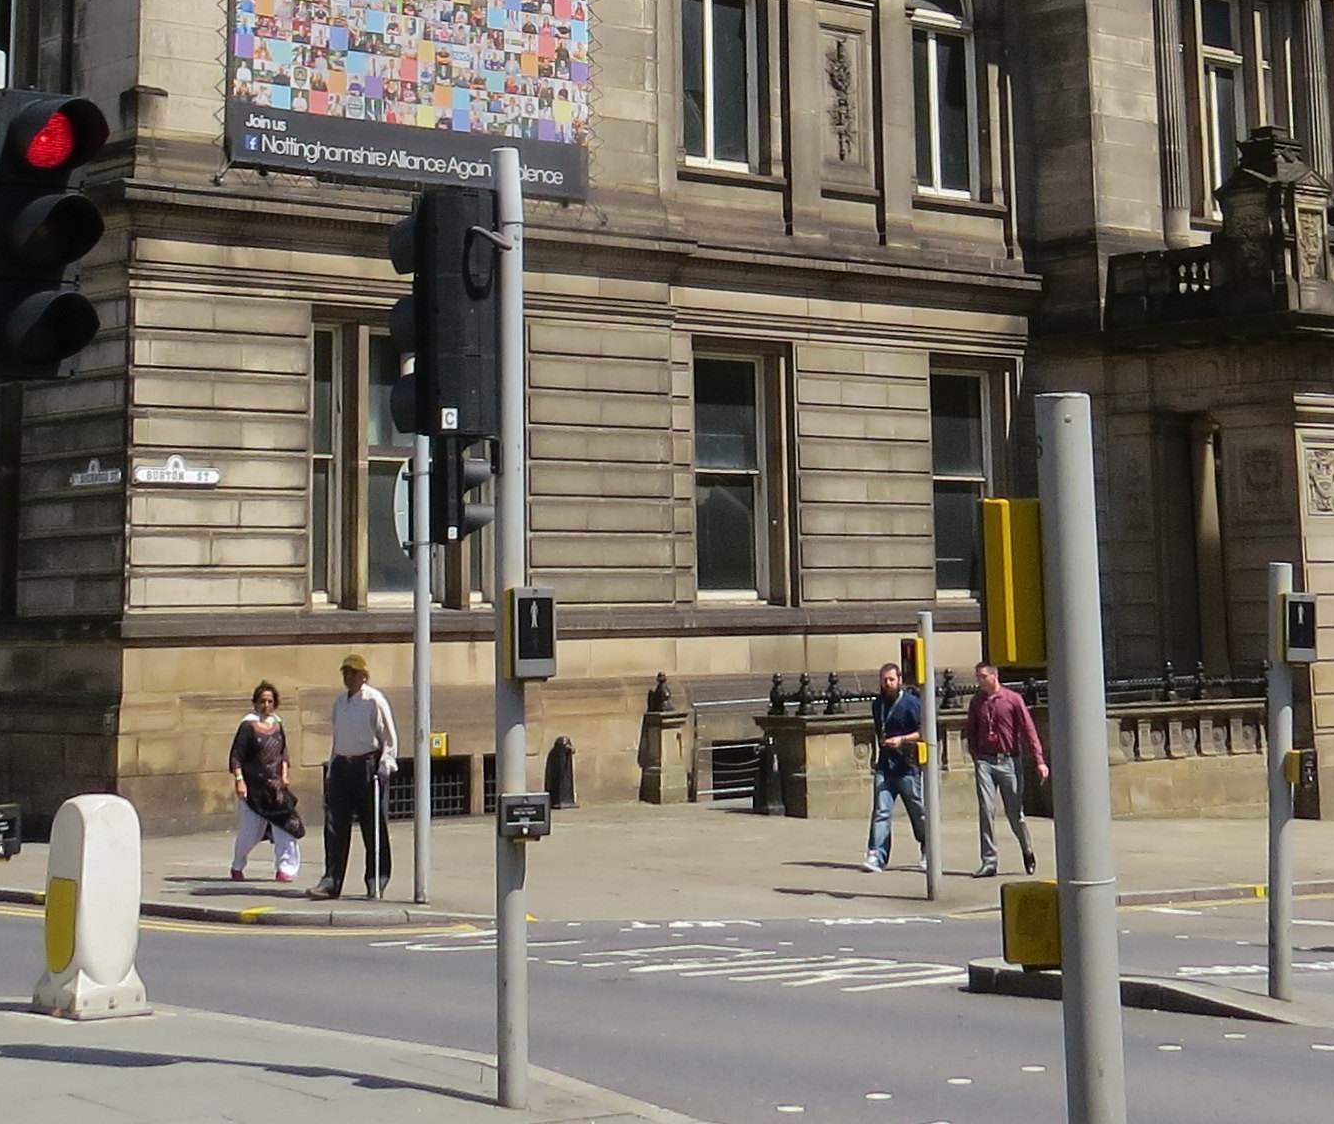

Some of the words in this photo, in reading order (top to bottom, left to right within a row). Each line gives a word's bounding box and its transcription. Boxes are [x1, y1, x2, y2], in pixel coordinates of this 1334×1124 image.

[245, 113, 271, 129] Join
[271, 117, 287, 132] us
[260, 133, 387, 167] Nottinghamshire
[387, 148, 447, 174] Alliance
[447, 156, 492, 180] Again
[445, 411, 455, 426] C
[146, 470, 185, 481] BURTON
